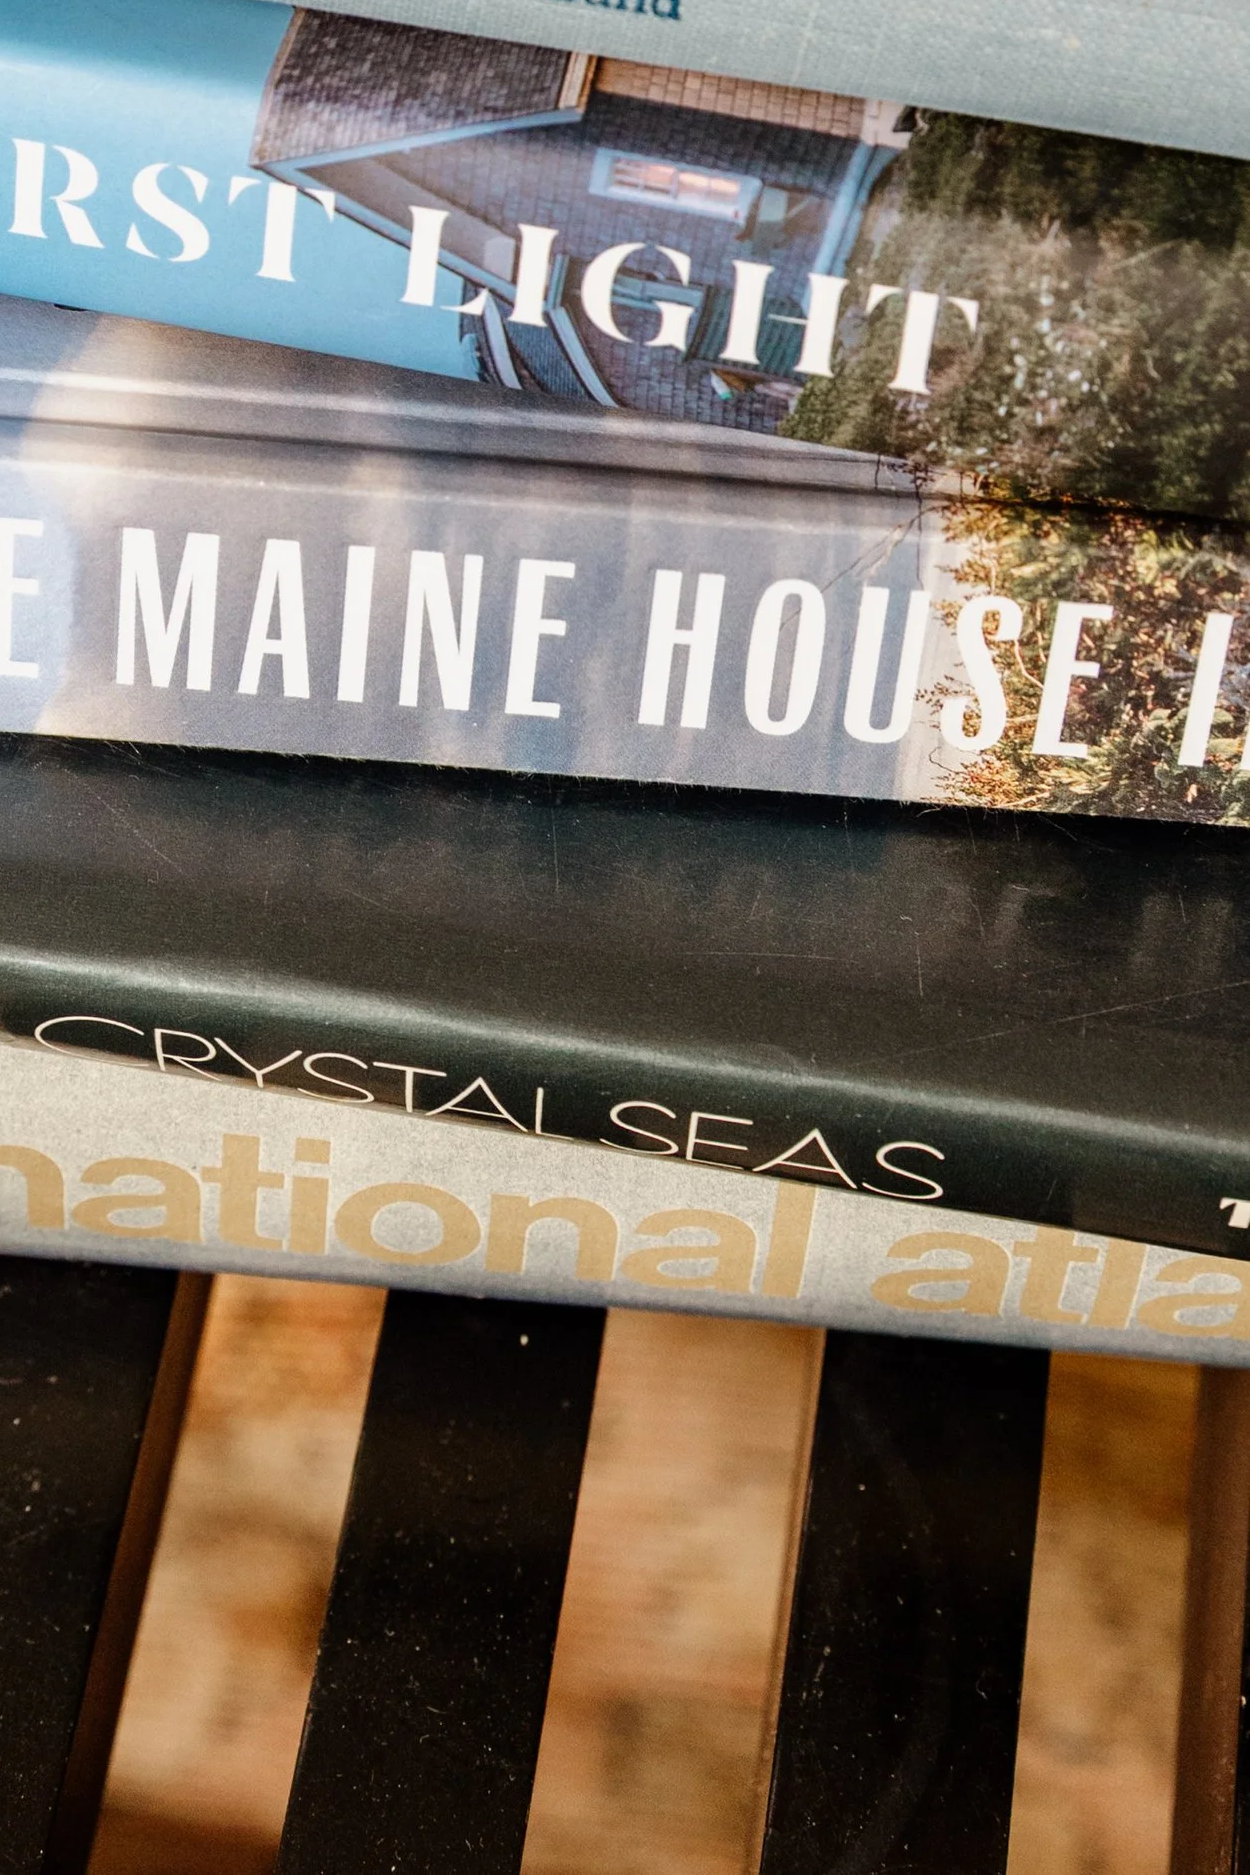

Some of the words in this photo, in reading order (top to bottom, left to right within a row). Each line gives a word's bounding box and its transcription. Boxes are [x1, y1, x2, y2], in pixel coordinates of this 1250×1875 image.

[400, 205, 979, 395] LIGHT
[116, 527, 576, 719] MAINE
[638, 569, 1114, 759] HOUSE
[35, 1015, 574, 1141] CRYSTAL
[598, 1100, 945, 1200] SEAS
